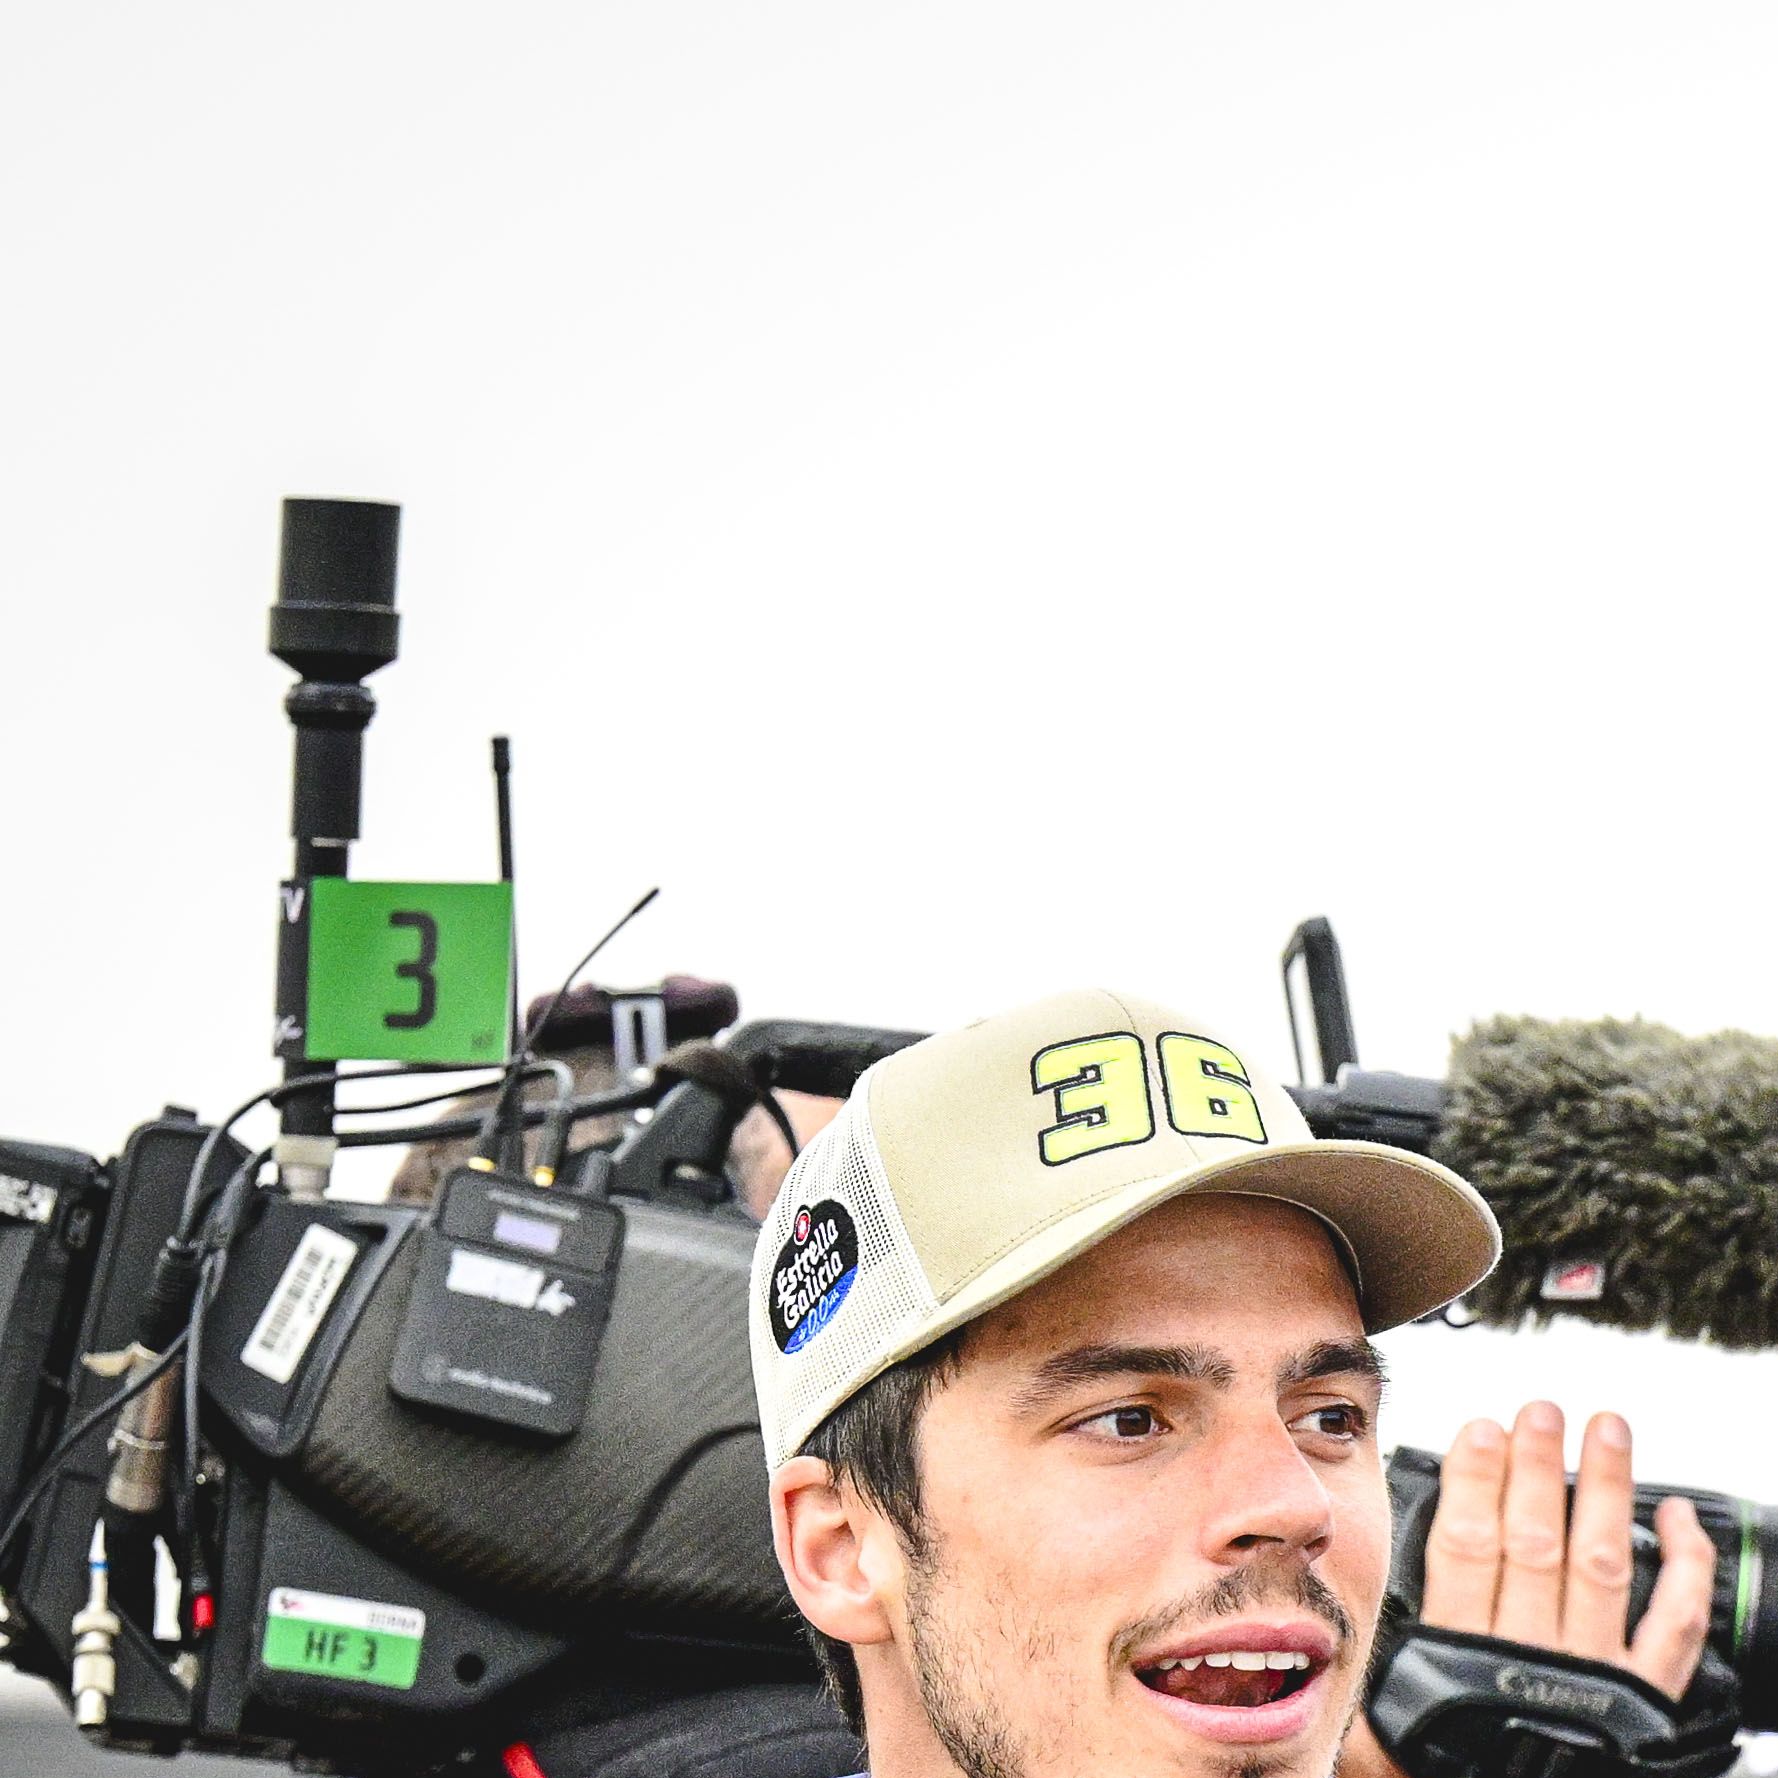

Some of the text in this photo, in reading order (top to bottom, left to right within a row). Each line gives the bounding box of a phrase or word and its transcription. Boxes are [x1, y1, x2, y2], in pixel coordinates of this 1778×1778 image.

[382, 910, 437, 1030] 3
[1030, 1031, 1268, 1167] 36
[775, 1219, 839, 1308] Estrella
[783, 1251, 844, 1330] Galicia
[305, 1629, 379, 1673] HF 3
